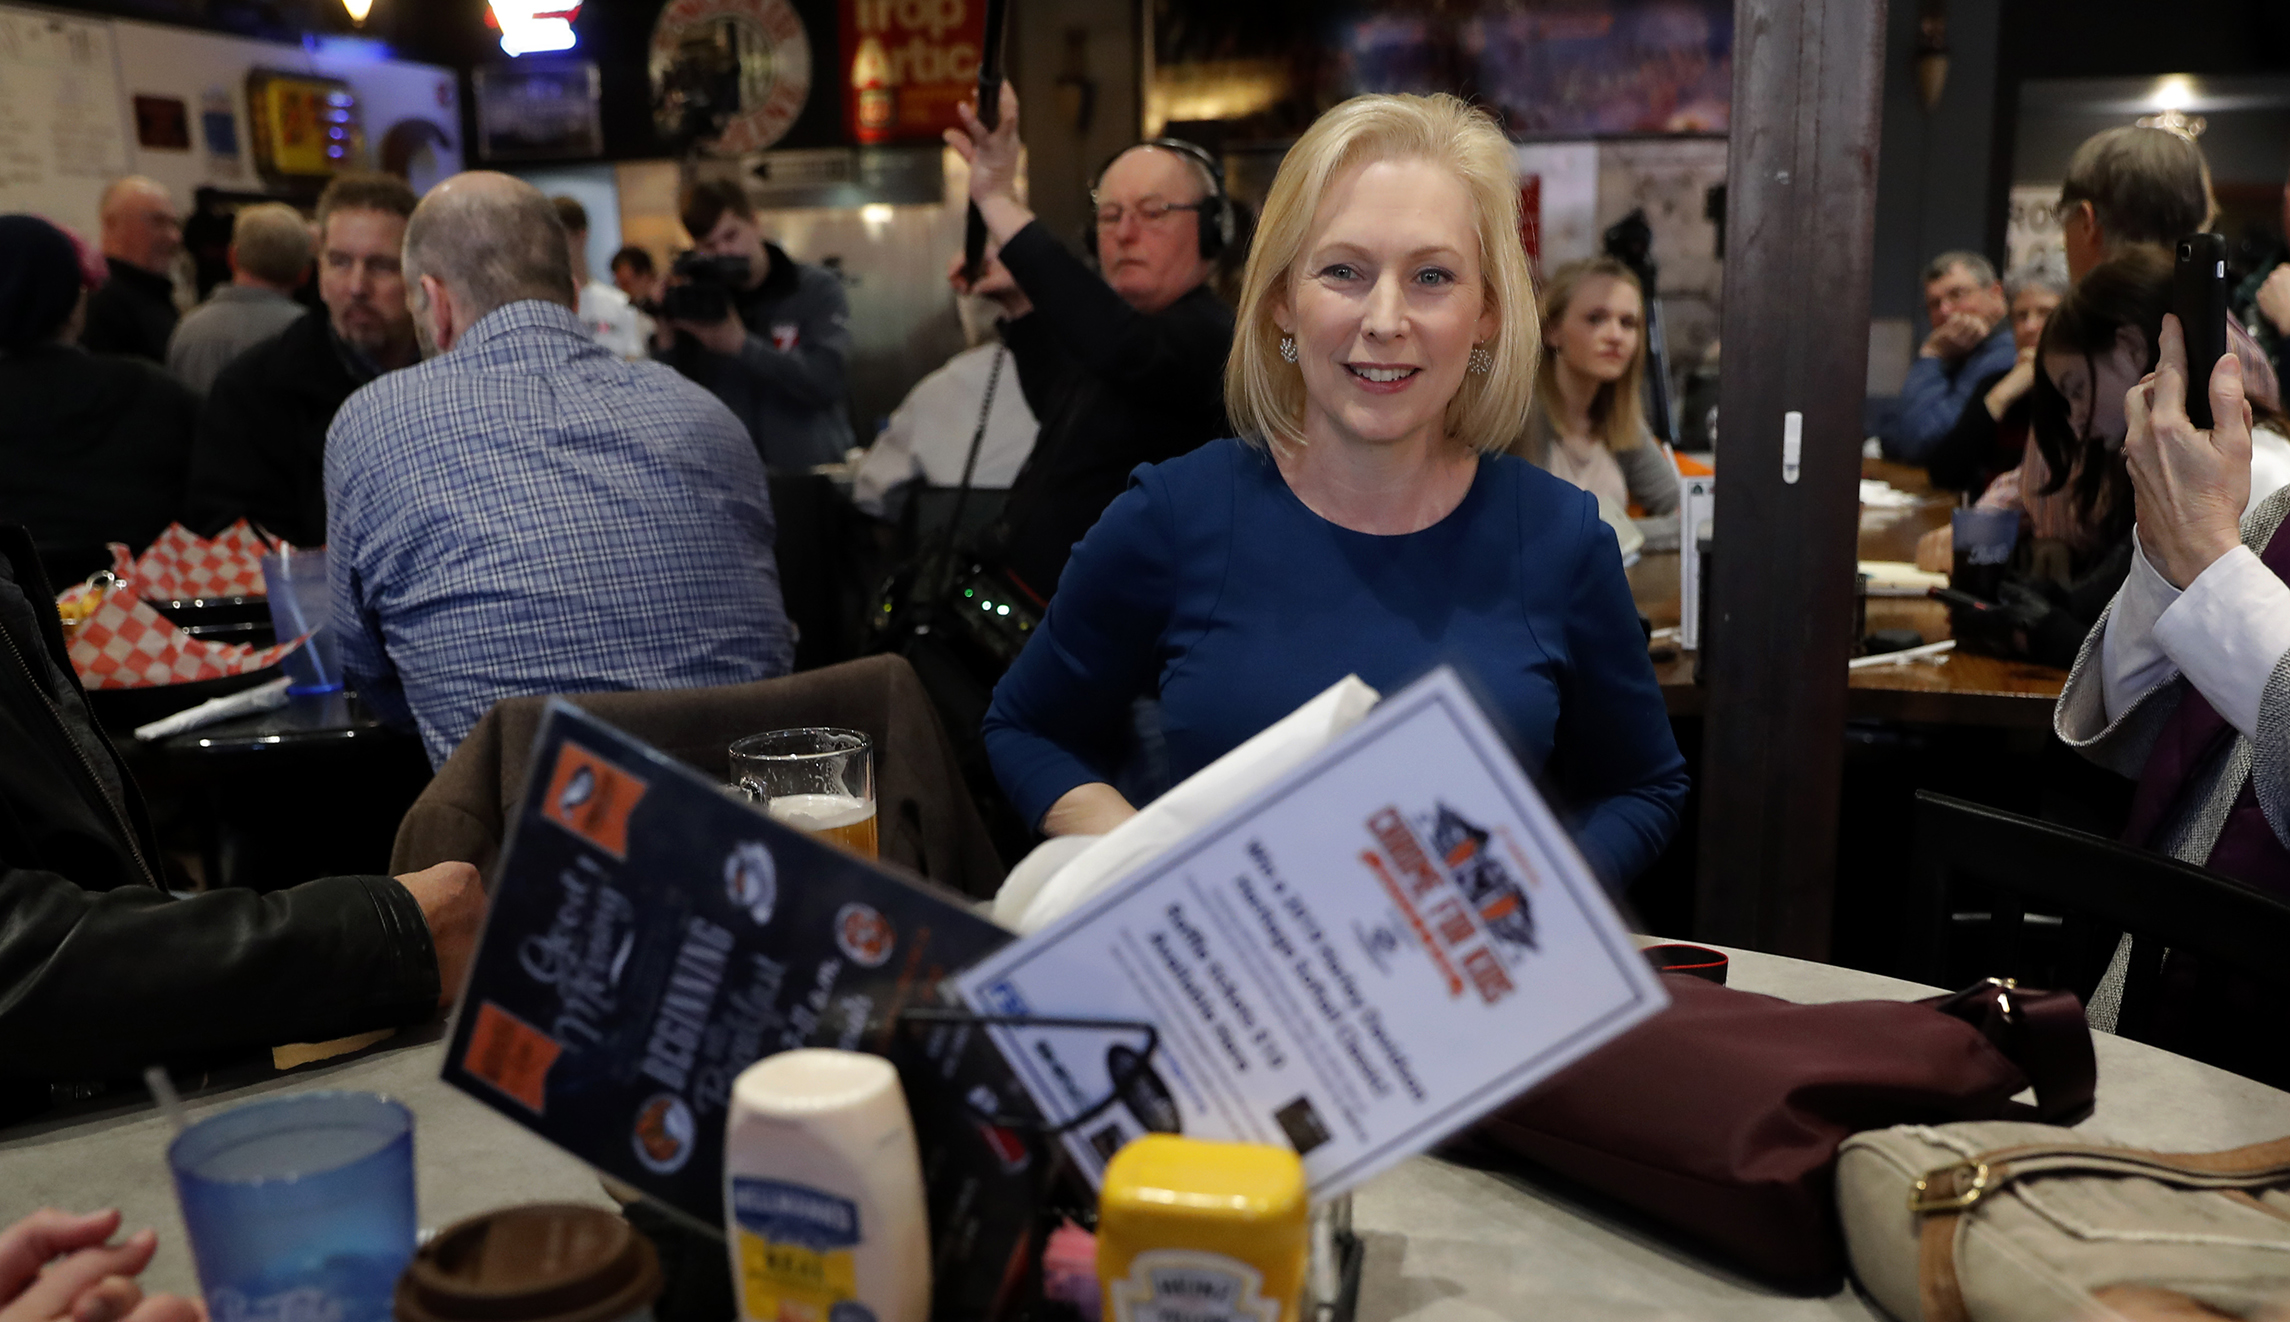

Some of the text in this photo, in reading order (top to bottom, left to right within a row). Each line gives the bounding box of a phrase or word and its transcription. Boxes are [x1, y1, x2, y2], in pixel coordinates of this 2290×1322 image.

[1147, 928, 1221, 1024] Available
[1363, 803, 1445, 901] CHROME
[1426, 895, 1478, 949] FOR
[1458, 943, 1518, 1008] KIDS
